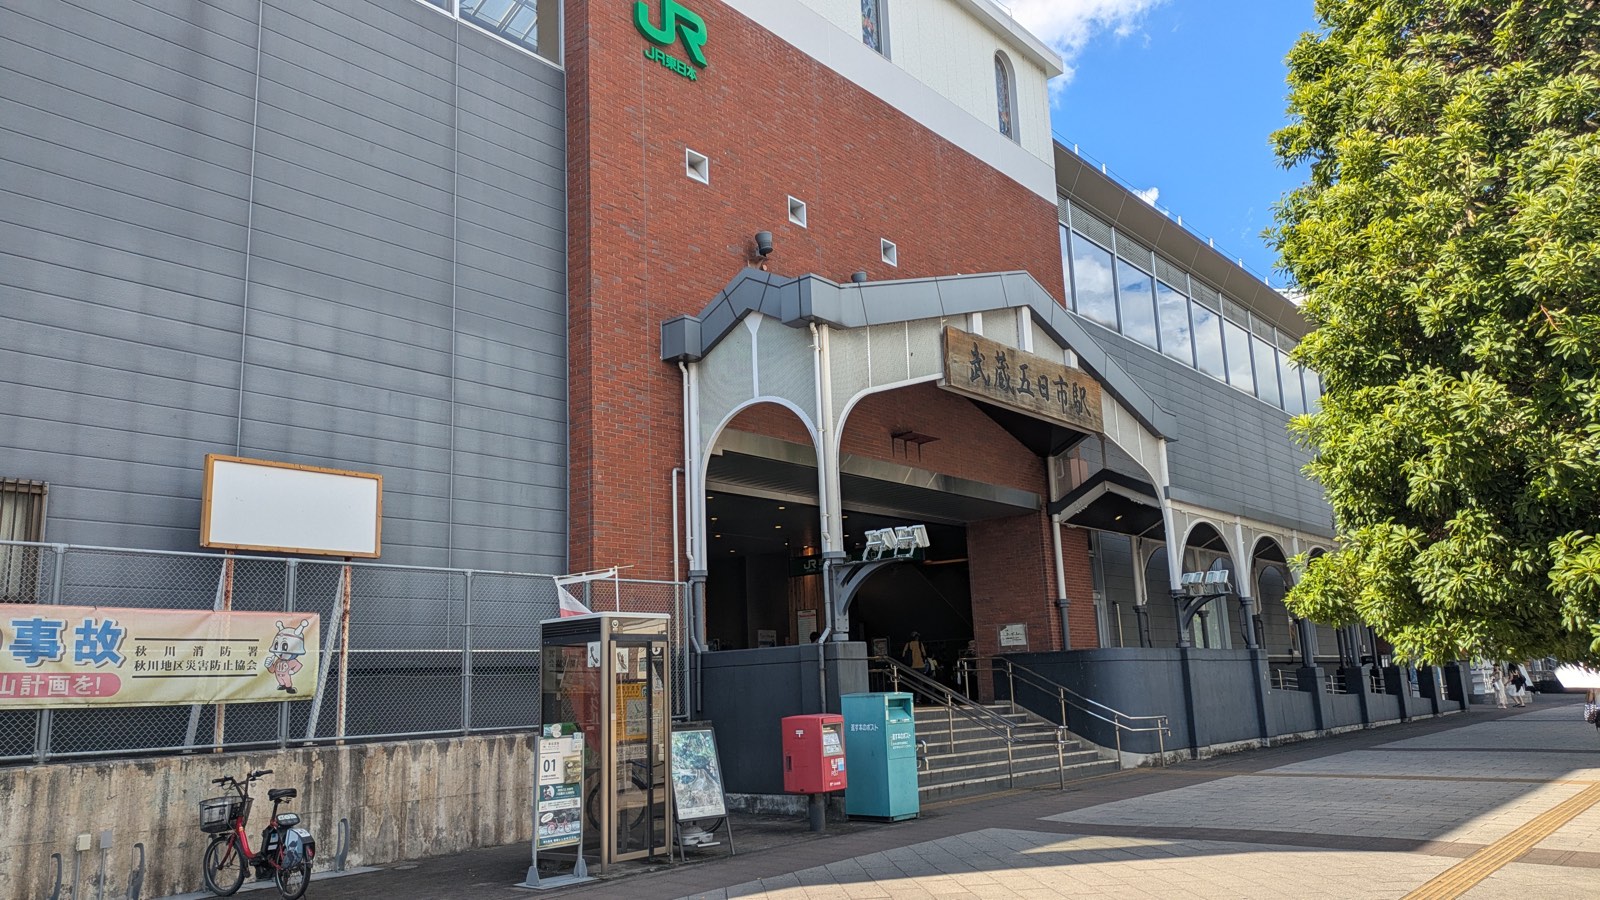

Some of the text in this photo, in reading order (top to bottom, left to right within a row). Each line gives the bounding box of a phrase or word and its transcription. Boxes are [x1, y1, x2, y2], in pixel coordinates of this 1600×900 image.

[633, 0, 708, 68] JR
[644, 46, 697, 81] JR東日本
[969, 341, 1092, 417] 武蔵五日市駅
[803, 559, 817, 570] JR
[0, 616, 126, 668] 事故
[135, 645, 259, 657] 秋川消防署
[134, 659, 258, 672] 秋川地区災害防止協会
[543, 758, 556, 773] 01
